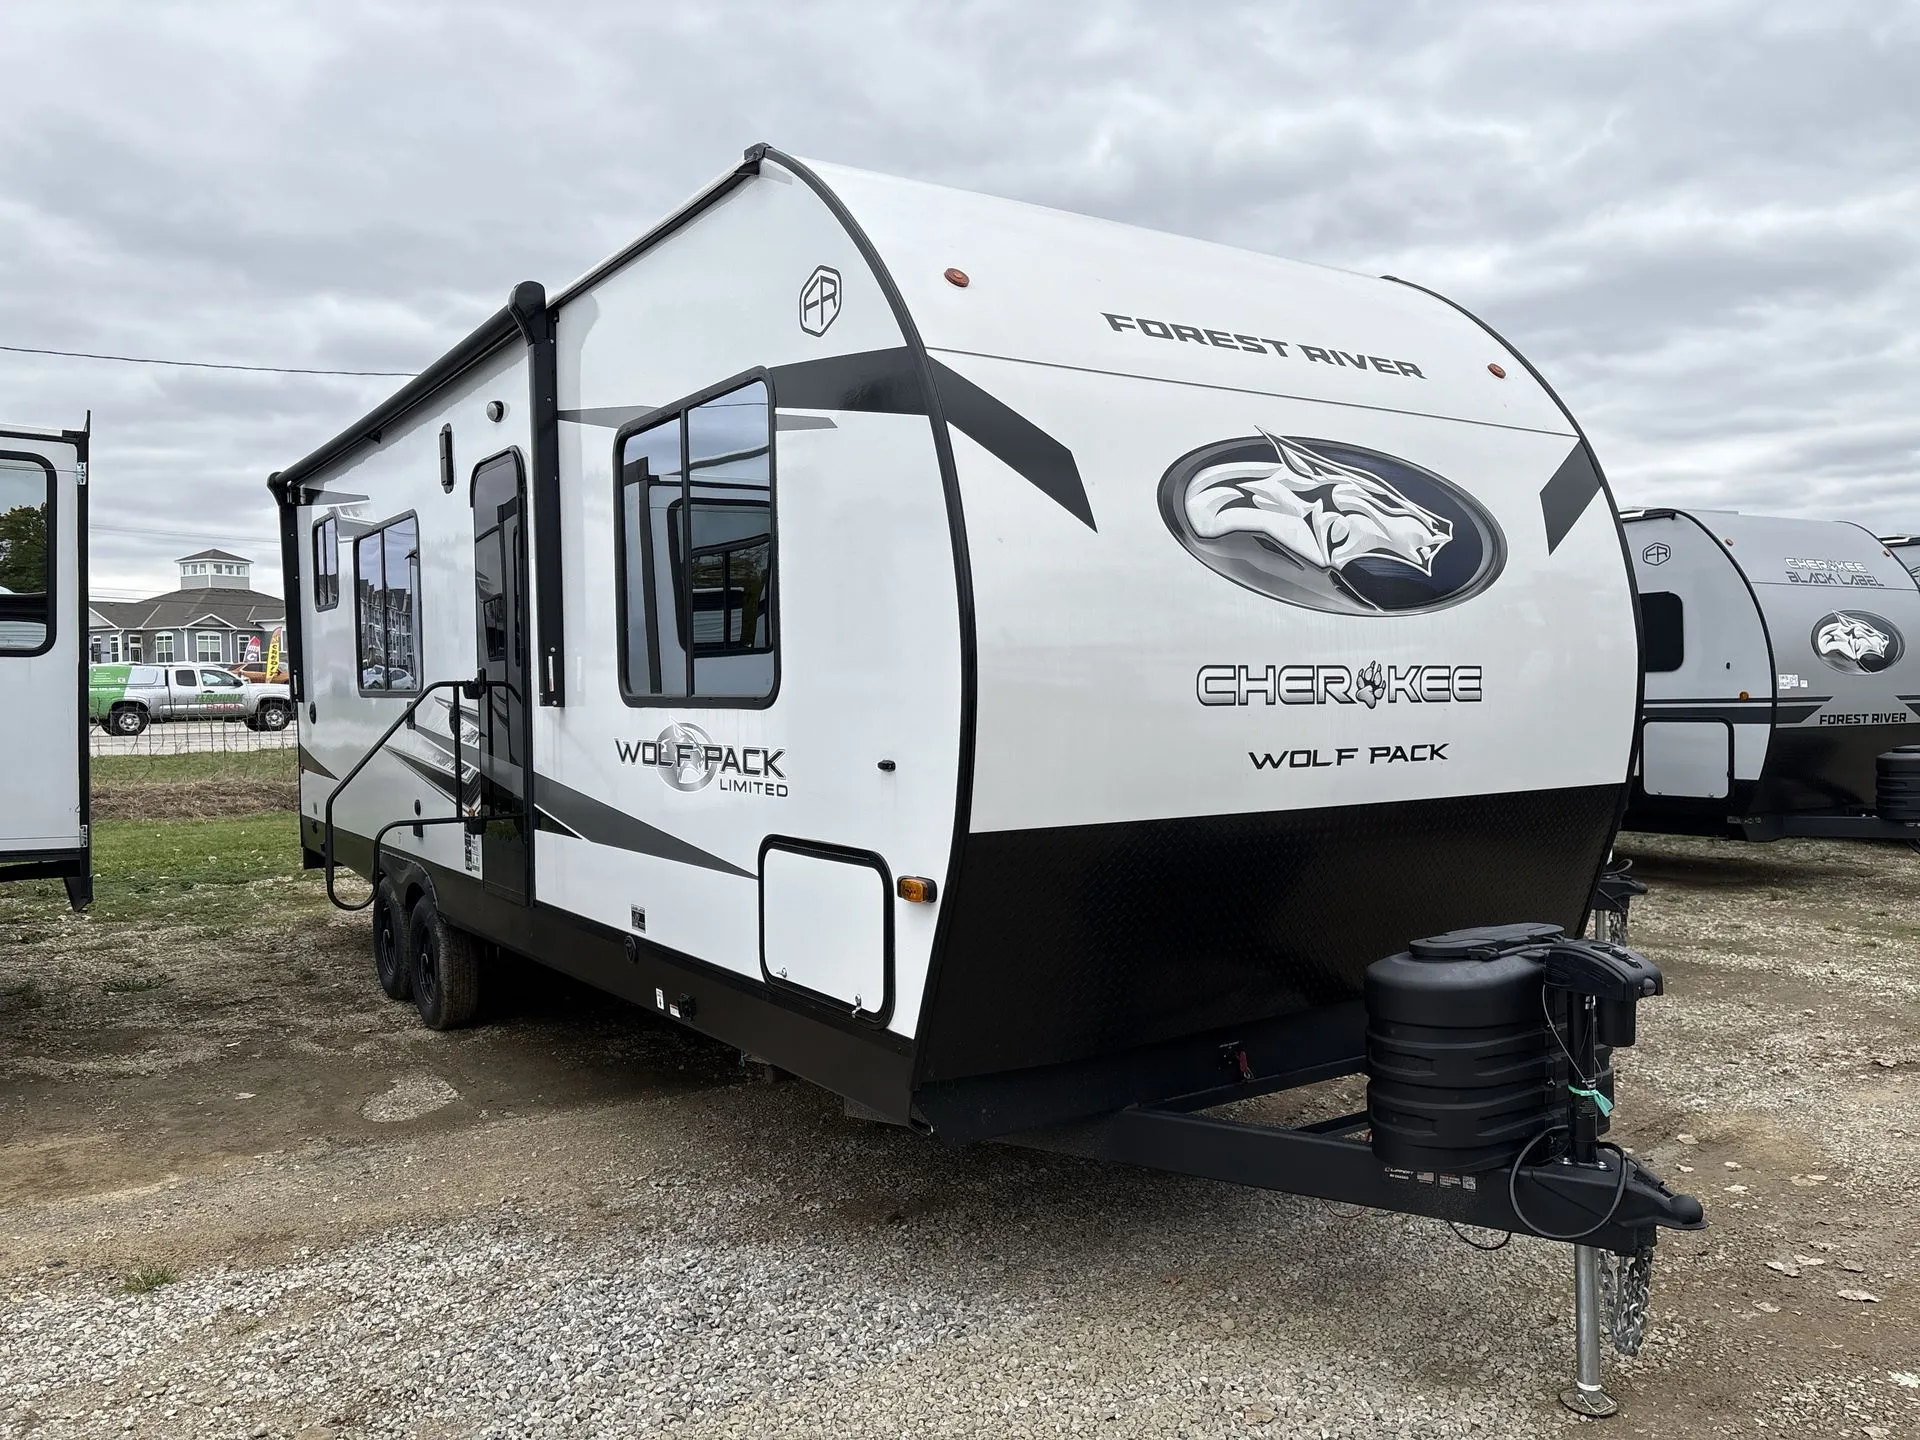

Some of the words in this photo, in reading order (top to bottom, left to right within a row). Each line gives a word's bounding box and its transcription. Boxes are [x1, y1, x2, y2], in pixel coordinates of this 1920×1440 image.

[1100, 312, 1288, 358] FOREST
[1297, 343, 1428, 380] RIVER
[1785, 571, 1838, 585] BLACK
[1837, 573, 1885, 587] LABEL
[1819, 713, 1869, 726] FOREST
[1871, 712, 1907, 724] RIVER
[614, 738, 693, 767] WOLF
[703, 745, 787, 780] PACK
[1248, 747, 1360, 770] WOLF
[1368, 743, 1450, 764] PACK
[719, 778, 789, 798] LIMITED
